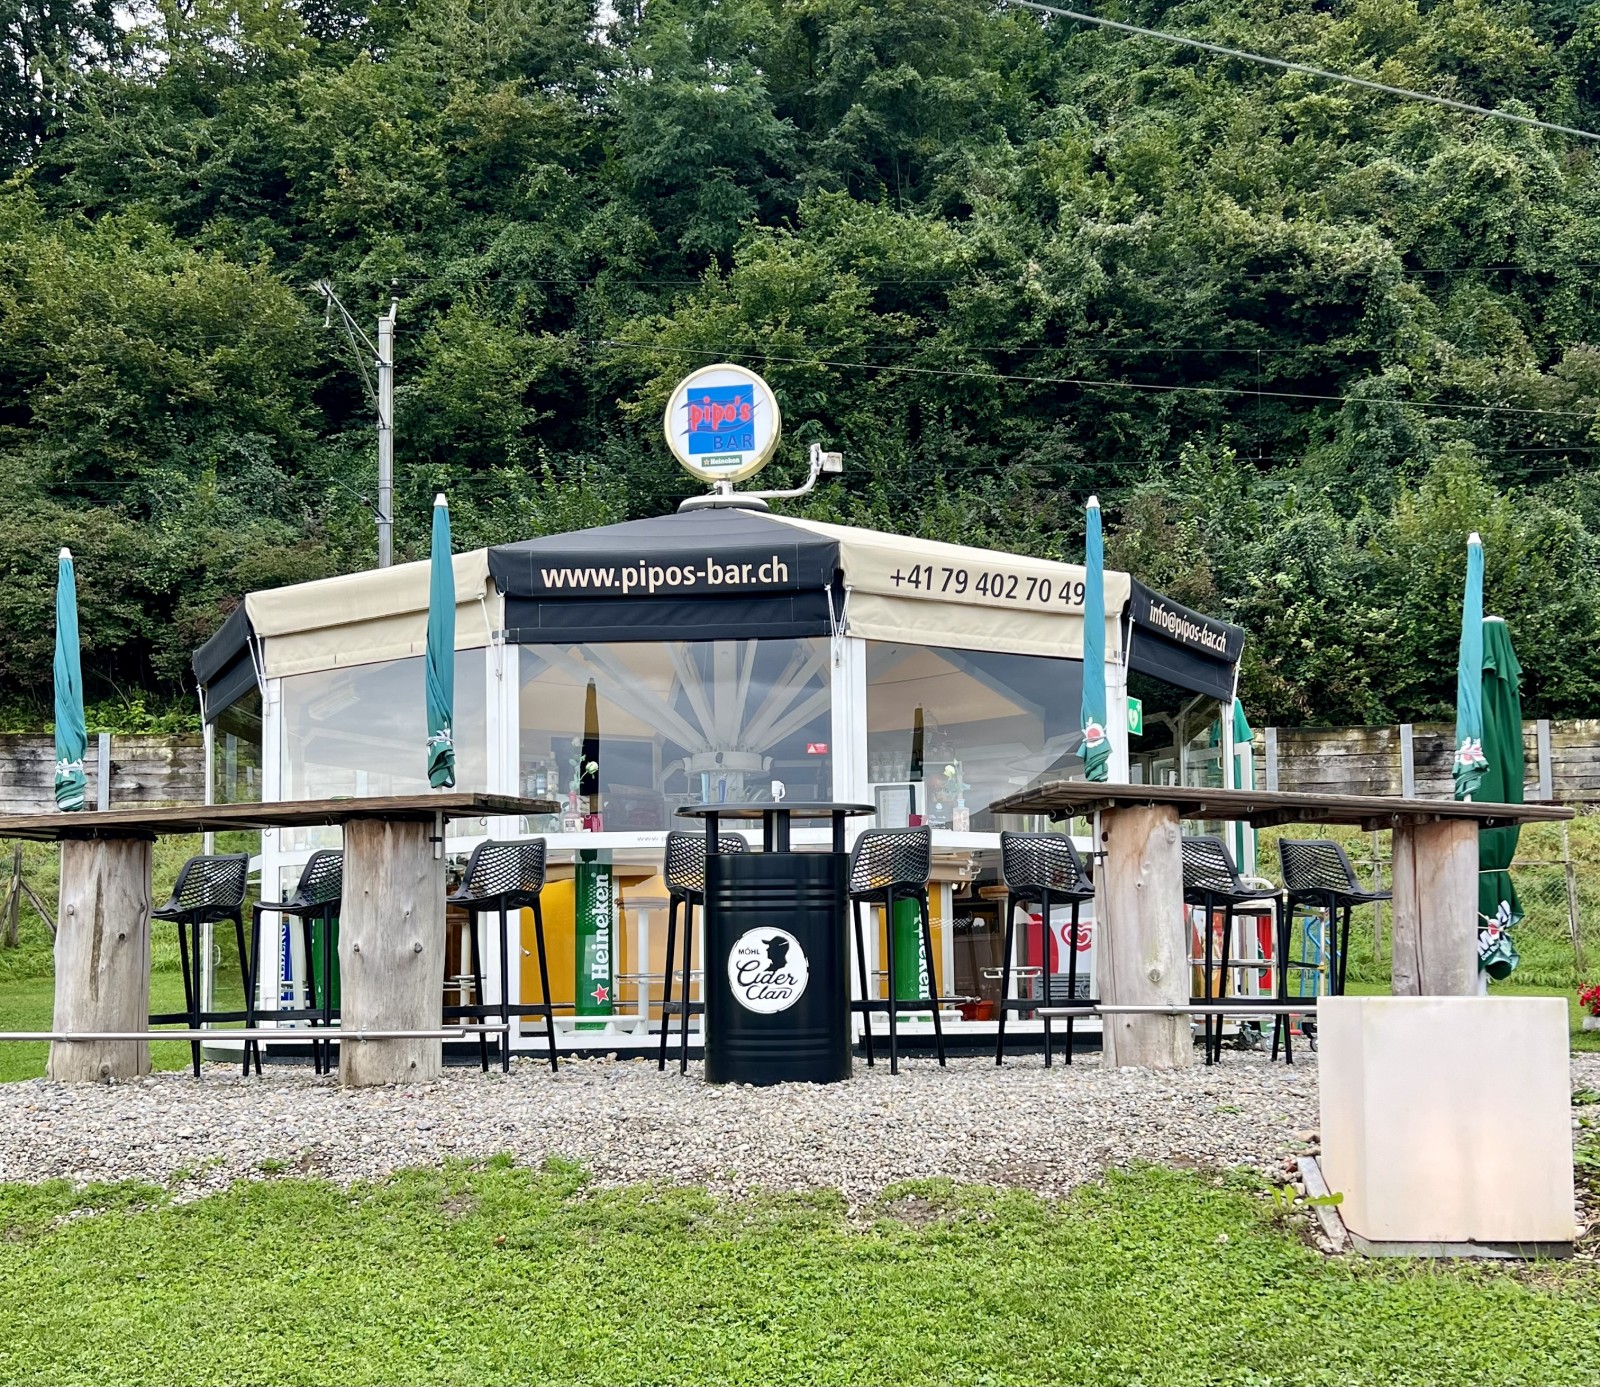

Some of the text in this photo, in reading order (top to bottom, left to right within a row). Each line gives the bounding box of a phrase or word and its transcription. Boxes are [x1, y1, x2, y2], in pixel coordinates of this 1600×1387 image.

[689, 396, 750, 431] pipo's
[713, 433, 754, 450] BAR
[710, 457, 740, 465] Heineken
[541, 556, 788, 593] www.pipos-bar.ch
[890, 564, 1086, 606] +41 79 402 70 49
[1149, 599, 1227, 653] info@pipos-bar.ch
[591, 873, 610, 981] Heineken
[738, 947, 760, 955] MÖHL
[736, 960, 798, 987] Cider
[746, 985, 793, 1000] Clan
